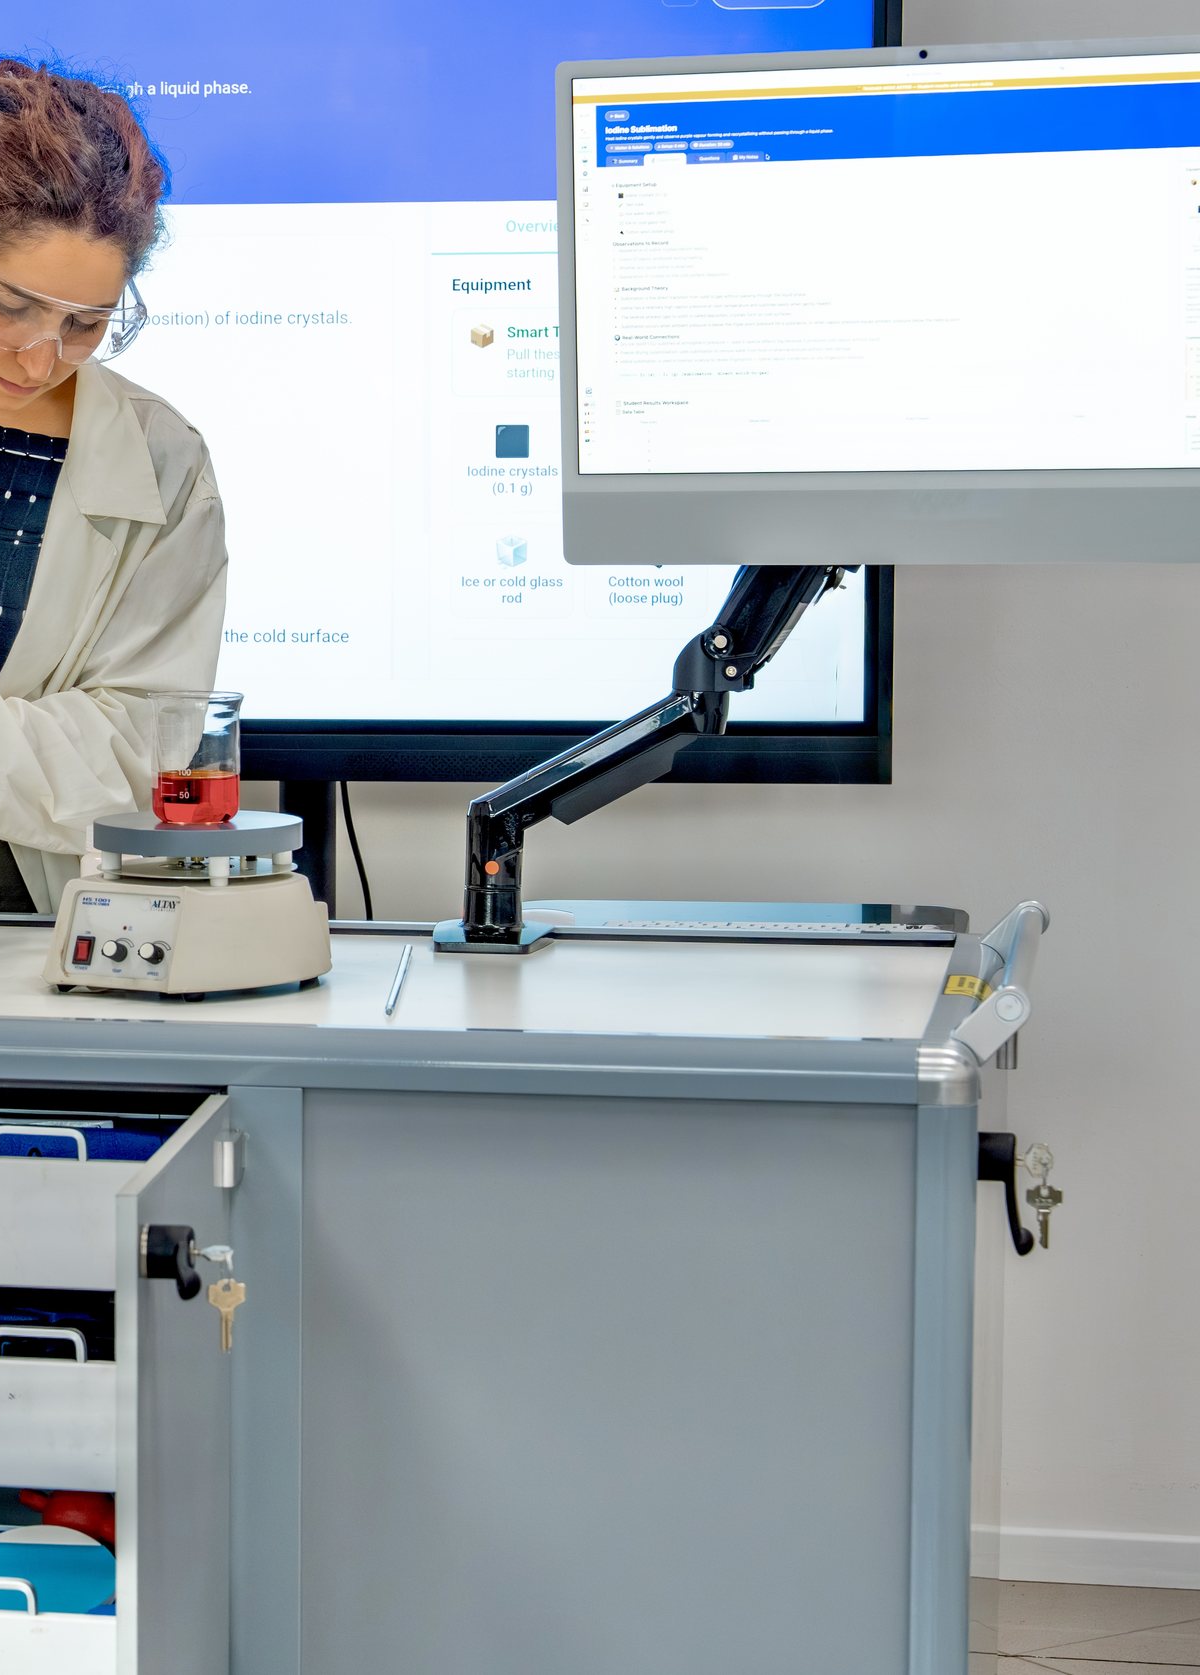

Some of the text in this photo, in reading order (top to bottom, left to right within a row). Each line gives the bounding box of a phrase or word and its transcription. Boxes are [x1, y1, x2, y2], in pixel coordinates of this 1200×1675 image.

[147, 84, 156, 95] a
[160, 80, 200, 98] liquid
[204, 81, 252, 98] phase.
[605, 126, 629, 135] Iodine
[630, 123, 677, 134] Sublimation
[506, 220, 558, 233] Overvie
[452, 278, 532, 294] Equipment
[215, 311, 231, 325] of
[235, 310, 283, 325] iodine
[287, 310, 353, 328] crystals.
[507, 326, 549, 338] Smart
[507, 349, 530, 360] Pull
[507, 367, 555, 380] starting
[467, 465, 558, 480] Iodine crystals
[492, 482, 533, 496] (0.1 g)
[461, 576, 563, 591] Ice or cold glass
[608, 576, 684, 587] Cotton wool
[502, 592, 522, 604] rod
[609, 592, 683, 606] (loose plug)
[224, 628, 349, 643] the cold surface
[178, 768, 192, 776] 100
[152, 900, 176, 909] ALTAY
